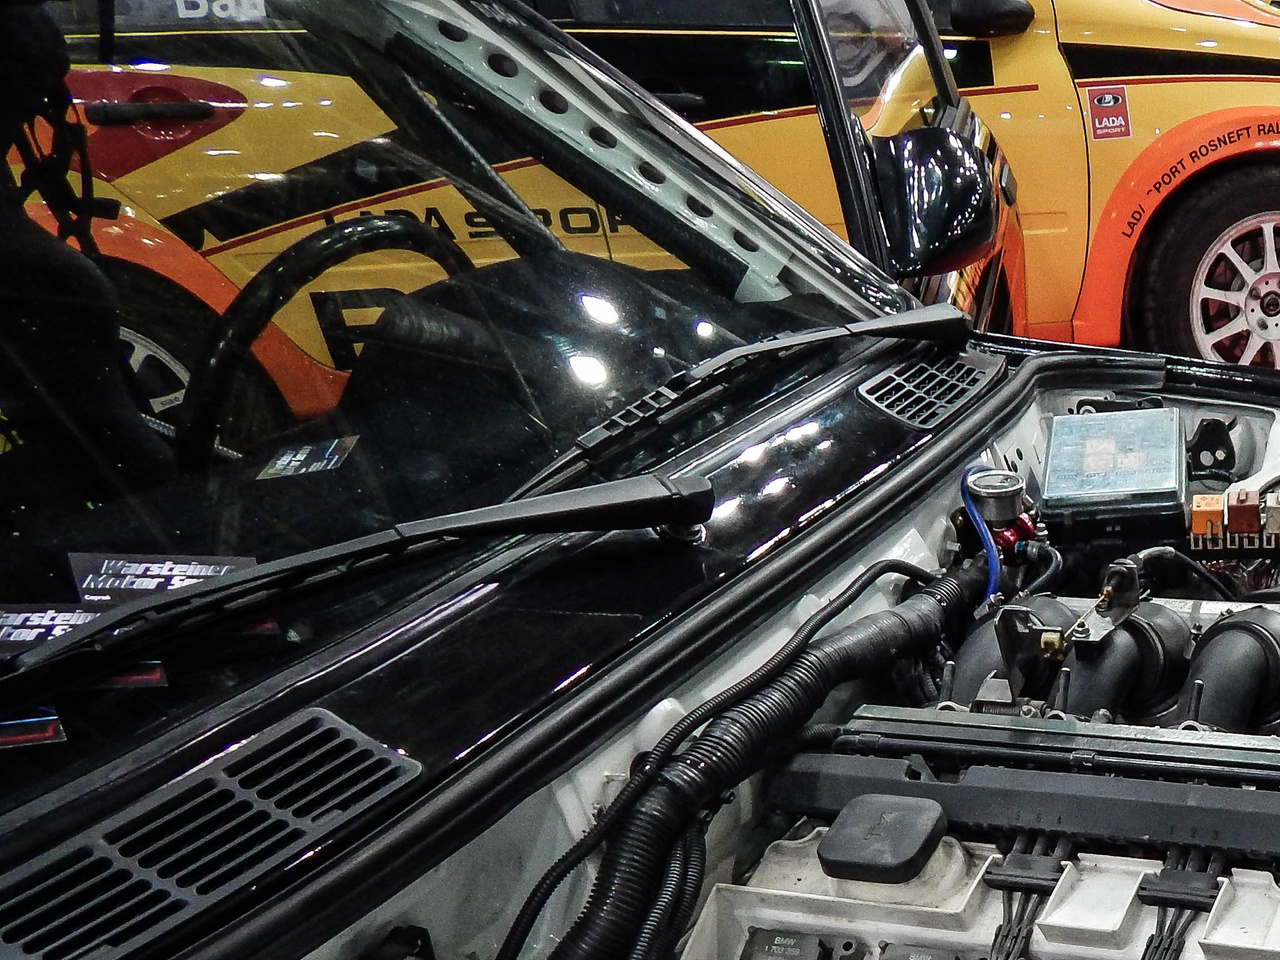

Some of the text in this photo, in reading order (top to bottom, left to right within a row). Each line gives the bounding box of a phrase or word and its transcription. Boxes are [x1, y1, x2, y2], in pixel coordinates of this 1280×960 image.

[1095, 116, 1125, 128] LADA
[1096, 127, 1125, 135] SPORT
[1189, 126, 1252, 164] ROSNEFT
[774, 936, 796, 945] BMW
[770, 946, 784, 954] 703
